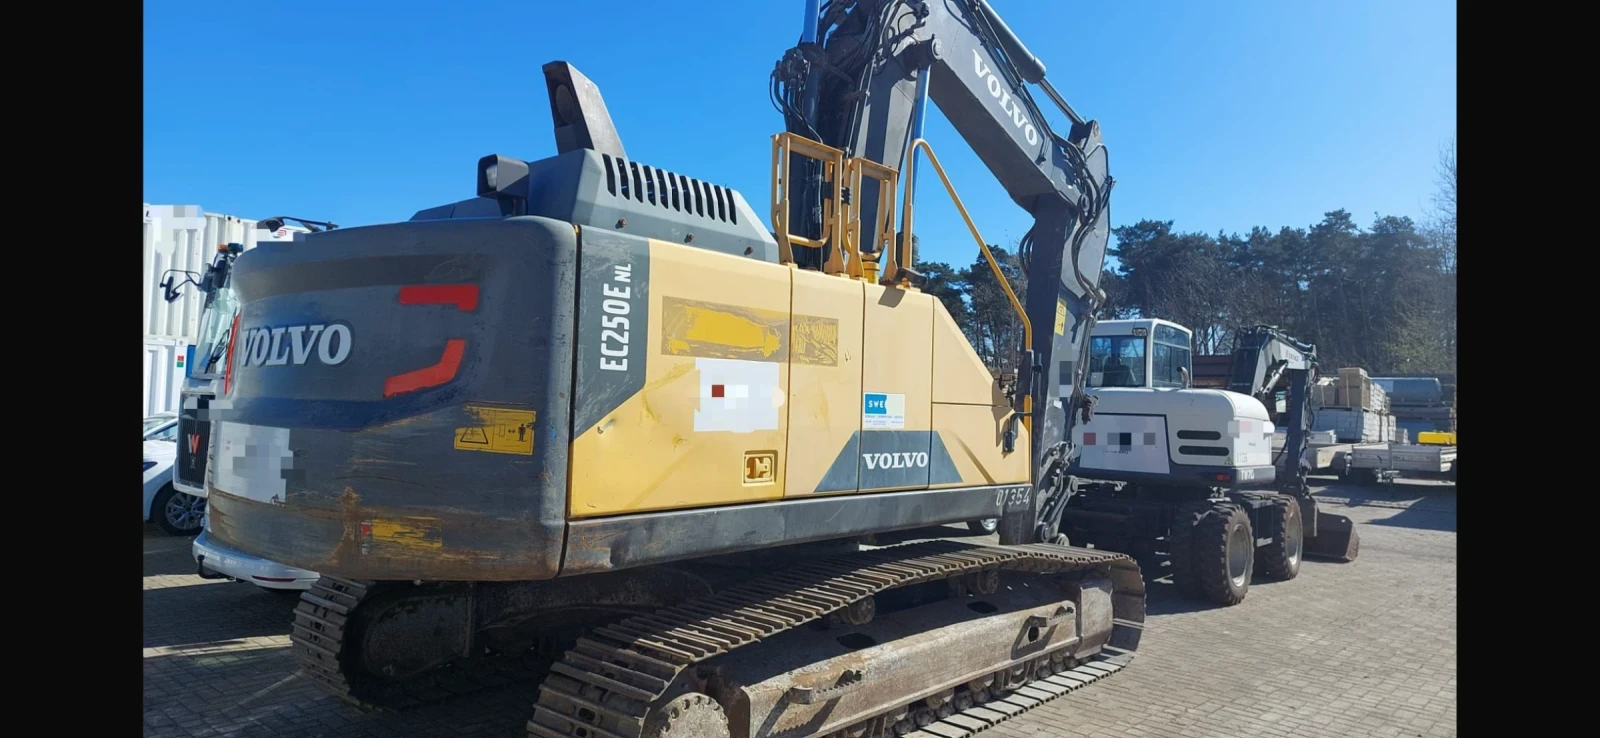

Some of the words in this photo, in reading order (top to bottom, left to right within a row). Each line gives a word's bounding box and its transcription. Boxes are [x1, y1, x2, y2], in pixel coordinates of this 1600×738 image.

[972, 48, 1038, 146] VOLVO
[240, 323, 352, 366] VOLVO
[862, 451, 929, 470] VOLVO
